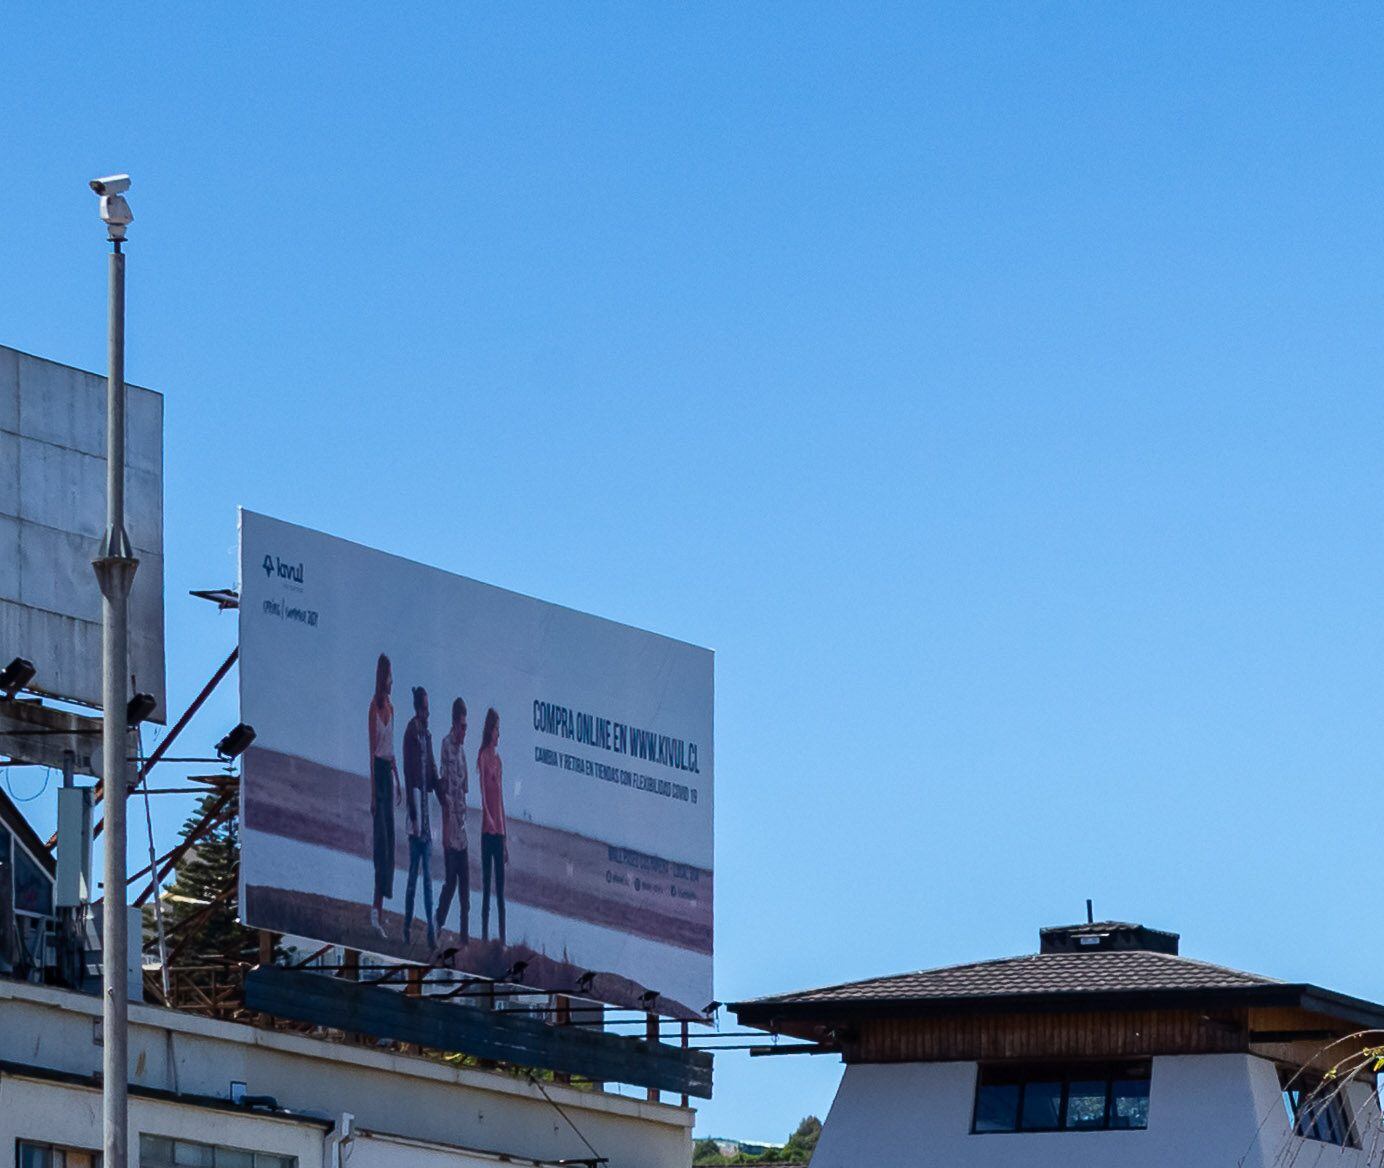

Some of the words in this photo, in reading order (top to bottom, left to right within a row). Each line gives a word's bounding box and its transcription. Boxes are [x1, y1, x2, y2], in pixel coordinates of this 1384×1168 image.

[533, 700, 574, 741] COMPRA
[576, 712, 611, 751] ONLINE
[613, 722, 627, 755] EN
[629, 726, 700, 774] WWW.KIVUL.CL
[564, 753, 585, 774] RETIRA
